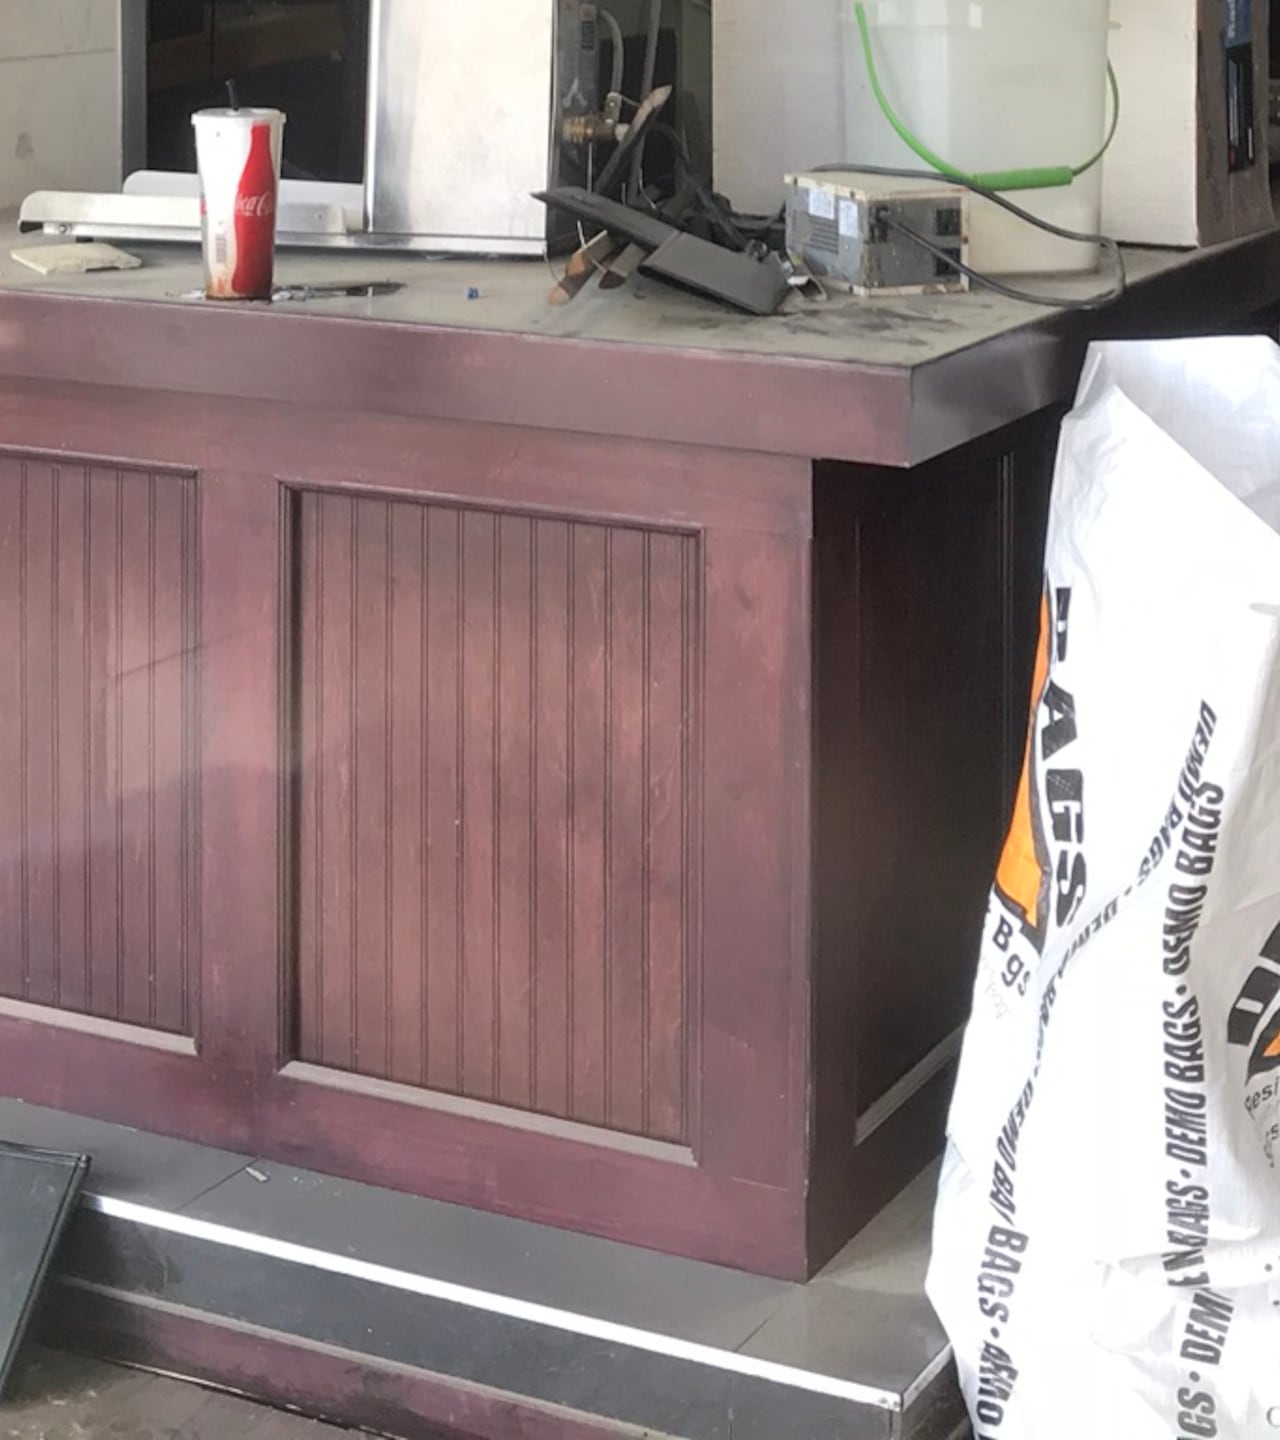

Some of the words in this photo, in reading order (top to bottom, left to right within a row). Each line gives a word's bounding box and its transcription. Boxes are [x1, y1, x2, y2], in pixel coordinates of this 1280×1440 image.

[1174, 780, 1225, 876] BAGS
[1162, 882, 1208, 977] DEMO
[1162, 994, 1205, 1084] BAGS
[1164, 1086, 1208, 1168] DEMO
[976, 1224, 1030, 1324] BAGS
